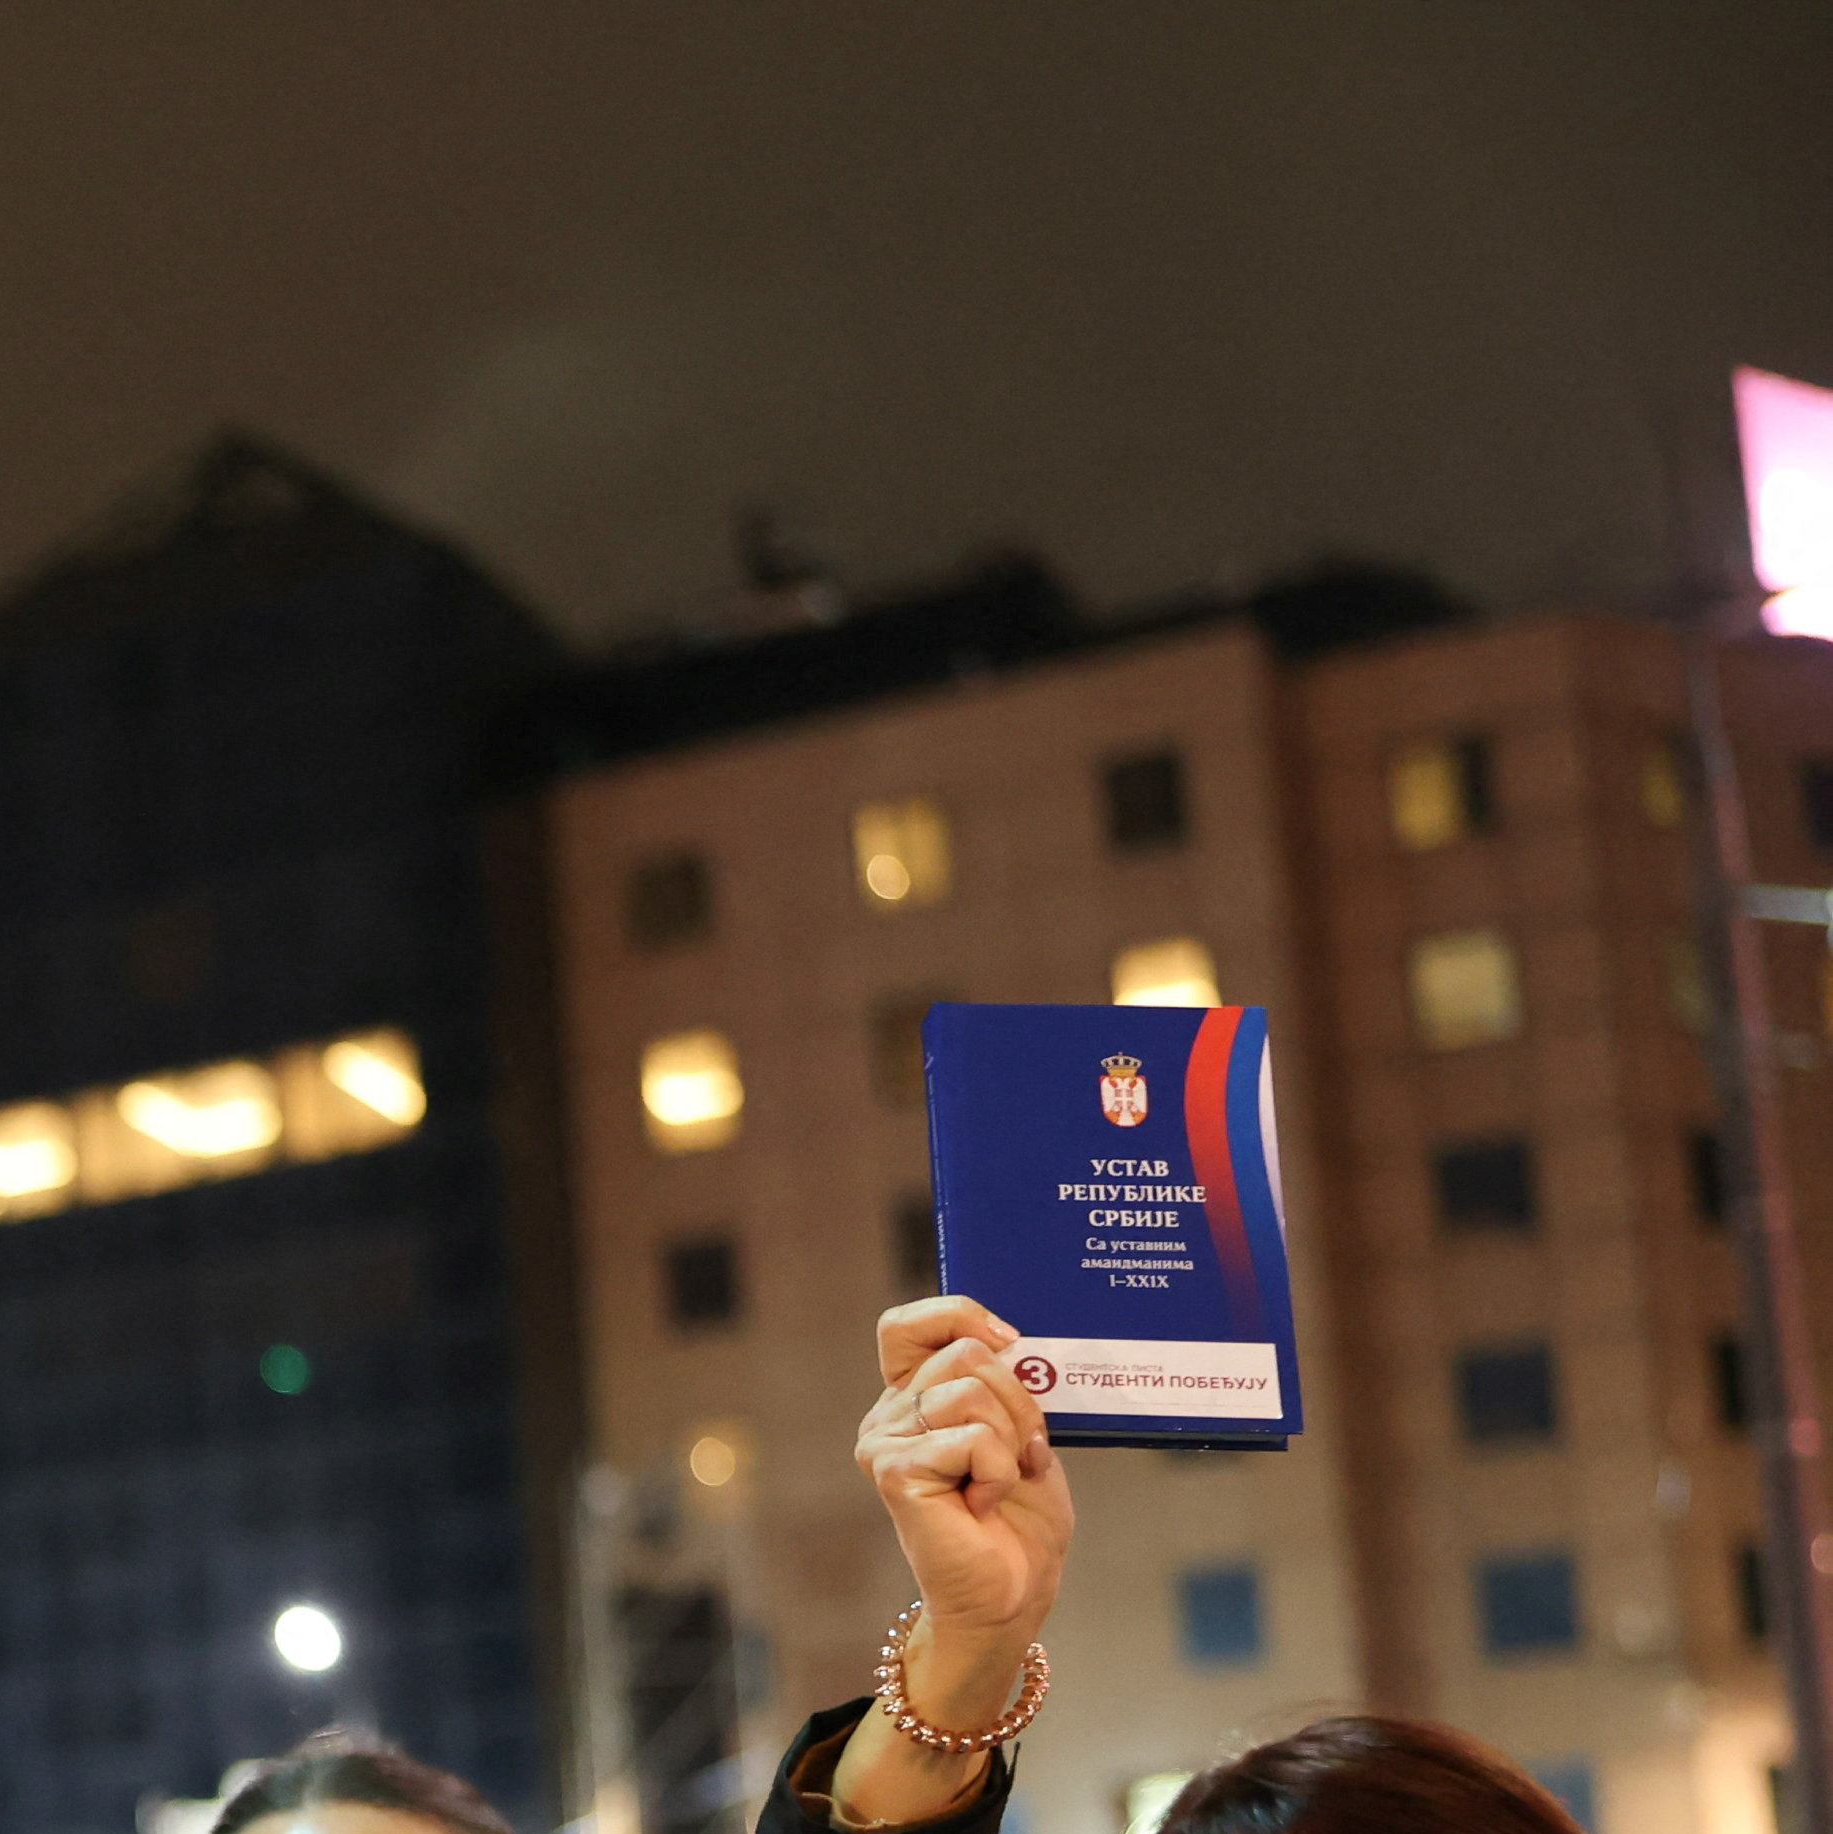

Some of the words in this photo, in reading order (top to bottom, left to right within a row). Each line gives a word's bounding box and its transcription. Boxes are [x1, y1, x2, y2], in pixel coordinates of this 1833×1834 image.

[1090, 1158, 1170, 1178] УСТАВ
[1057, 1184, 1207, 1204] РЕПУБЛИКЕ
[1088, 1209, 1180, 1230] СРБИЈЕ
[1085, 1236, 1106, 1251] Са
[1110, 1238, 1187, 1256] уставним
[1021, 1359, 1049, 1392] 3
[1066, 1372, 1165, 1388] СТУДЕНТИ
[1170, 1376, 1268, 1391] ПОБЕЂУЈУ
